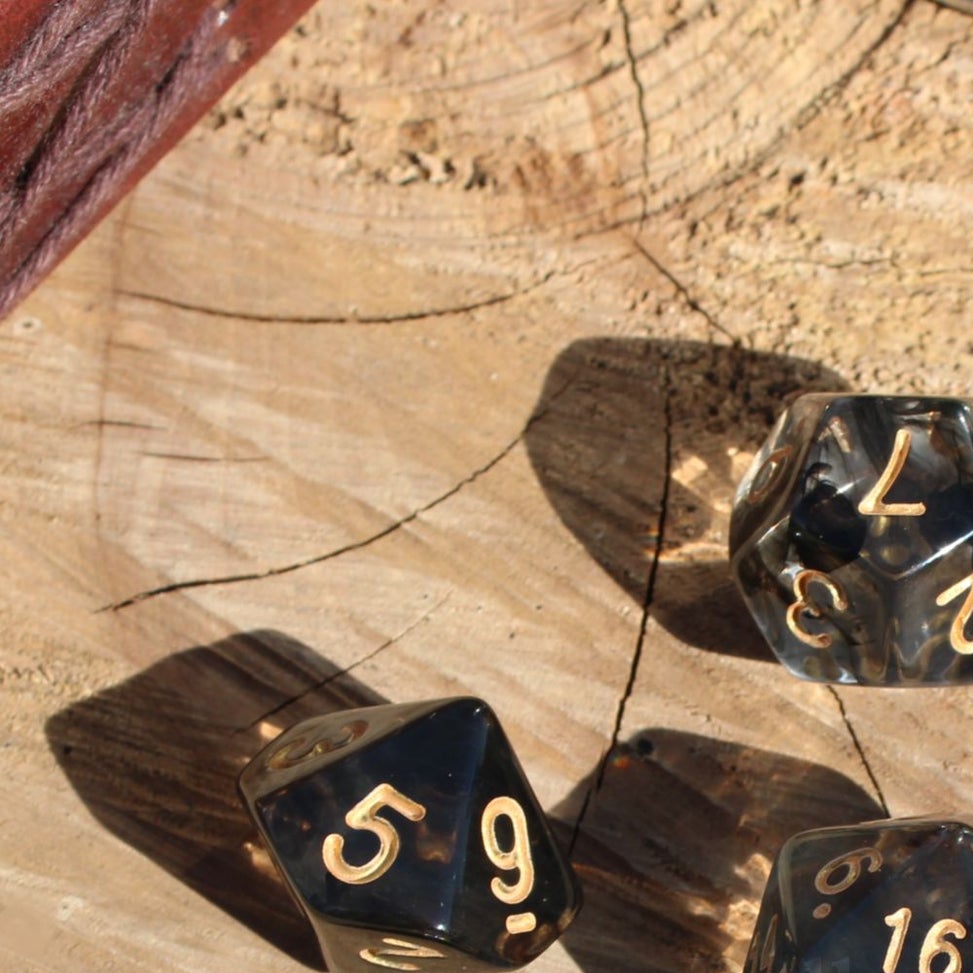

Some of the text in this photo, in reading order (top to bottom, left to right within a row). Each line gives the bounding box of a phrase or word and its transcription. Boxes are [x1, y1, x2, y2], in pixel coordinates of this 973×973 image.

[858, 428, 926, 516] 7
[786, 569, 847, 648] 3
[322, 783, 426, 885] 5
